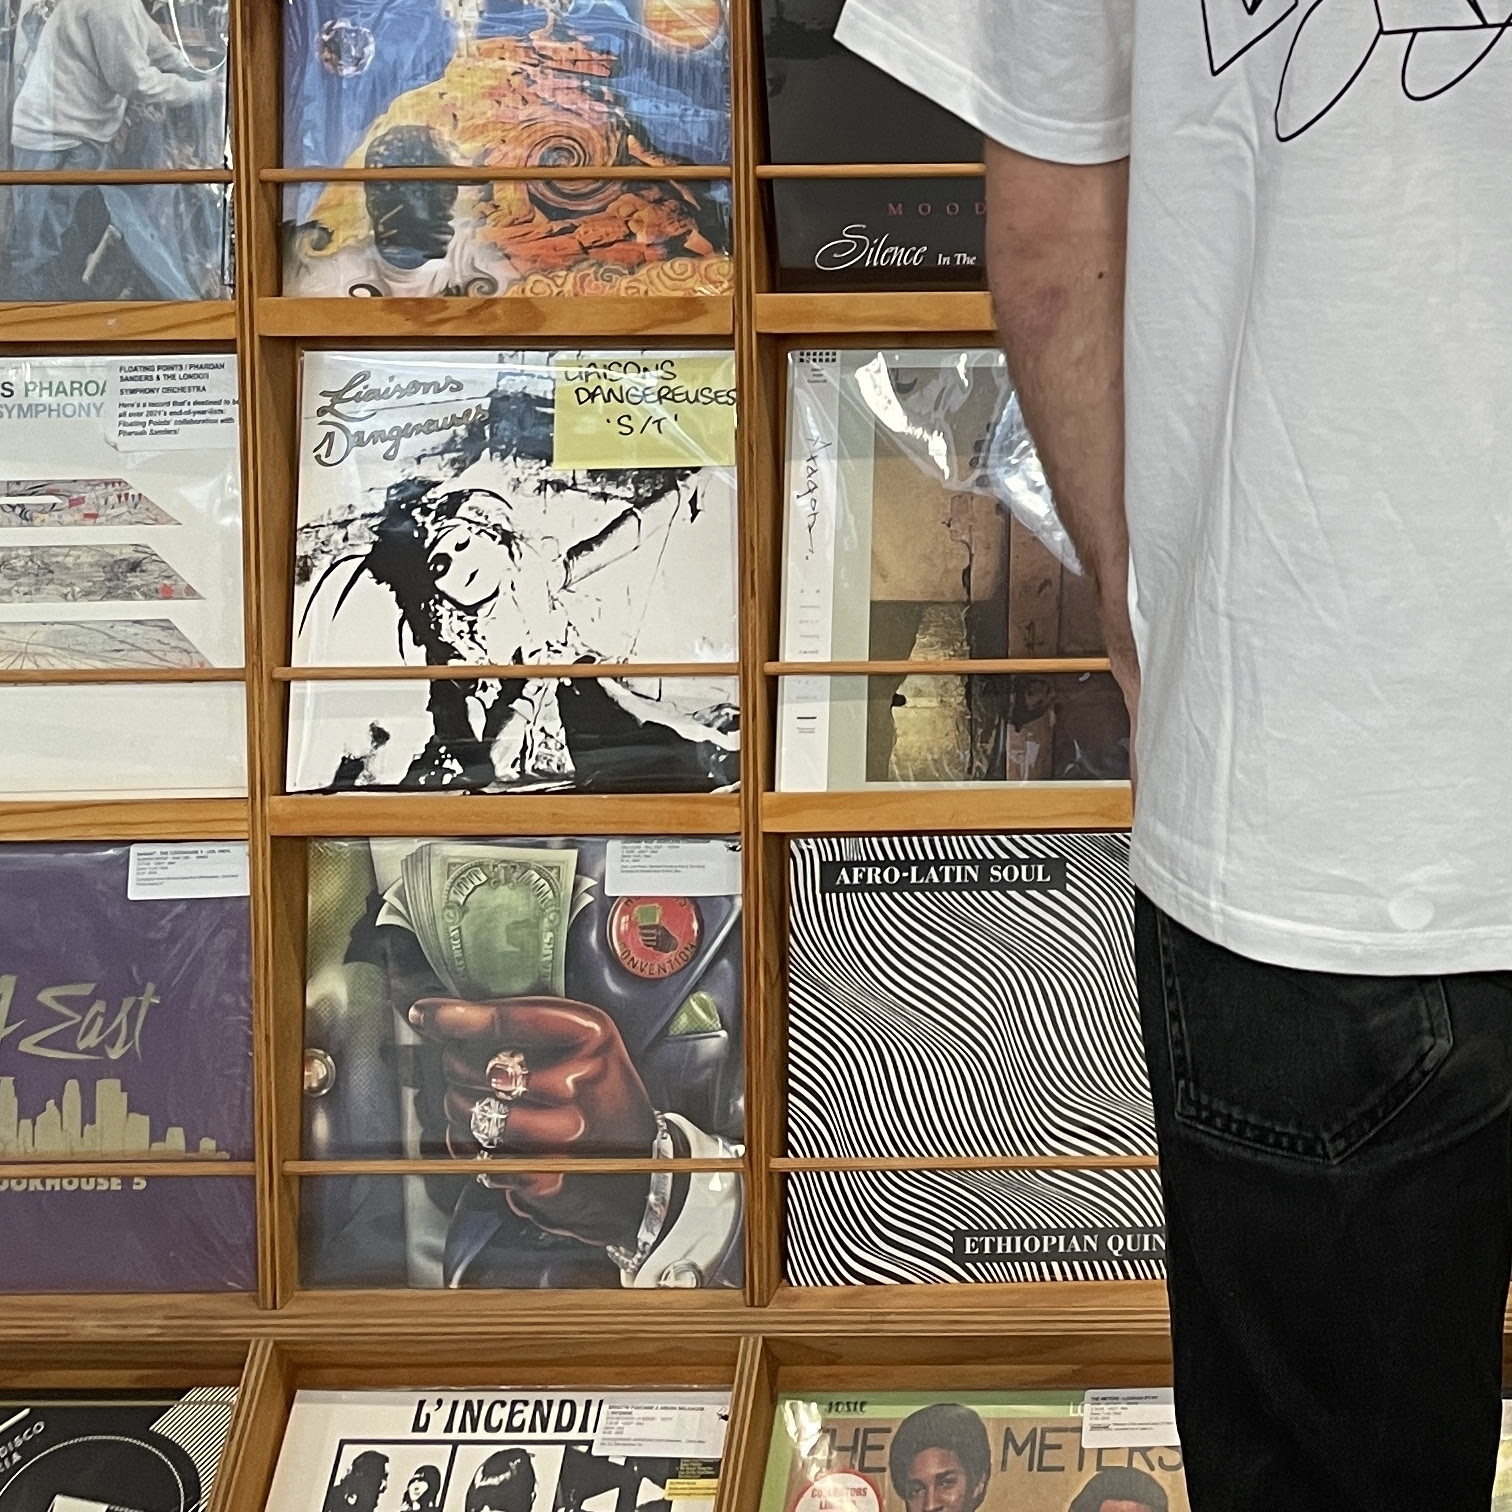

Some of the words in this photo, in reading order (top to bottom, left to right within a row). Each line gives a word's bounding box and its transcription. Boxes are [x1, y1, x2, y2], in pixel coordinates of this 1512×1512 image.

[815, 224, 929, 271] Silence
[937, 254, 950, 266] In
[954, 253, 977, 266] The
[119, 365, 155, 373] FLOATING
[157, 364, 183, 372] POINTS
[119, 374, 154, 382] SANDERS
[120, 387, 160, 395] SYMPHONY
[316, 371, 464, 422] Liaisons
[575, 385, 738, 406] DANGEREUSES
[313, 404, 490, 467] Dangereuses
[835, 864, 980, 885] AFRO-LATIN
[989, 864, 1052, 884] SOUL
[963, 1234, 1099, 1255] ETHIOPIAN
